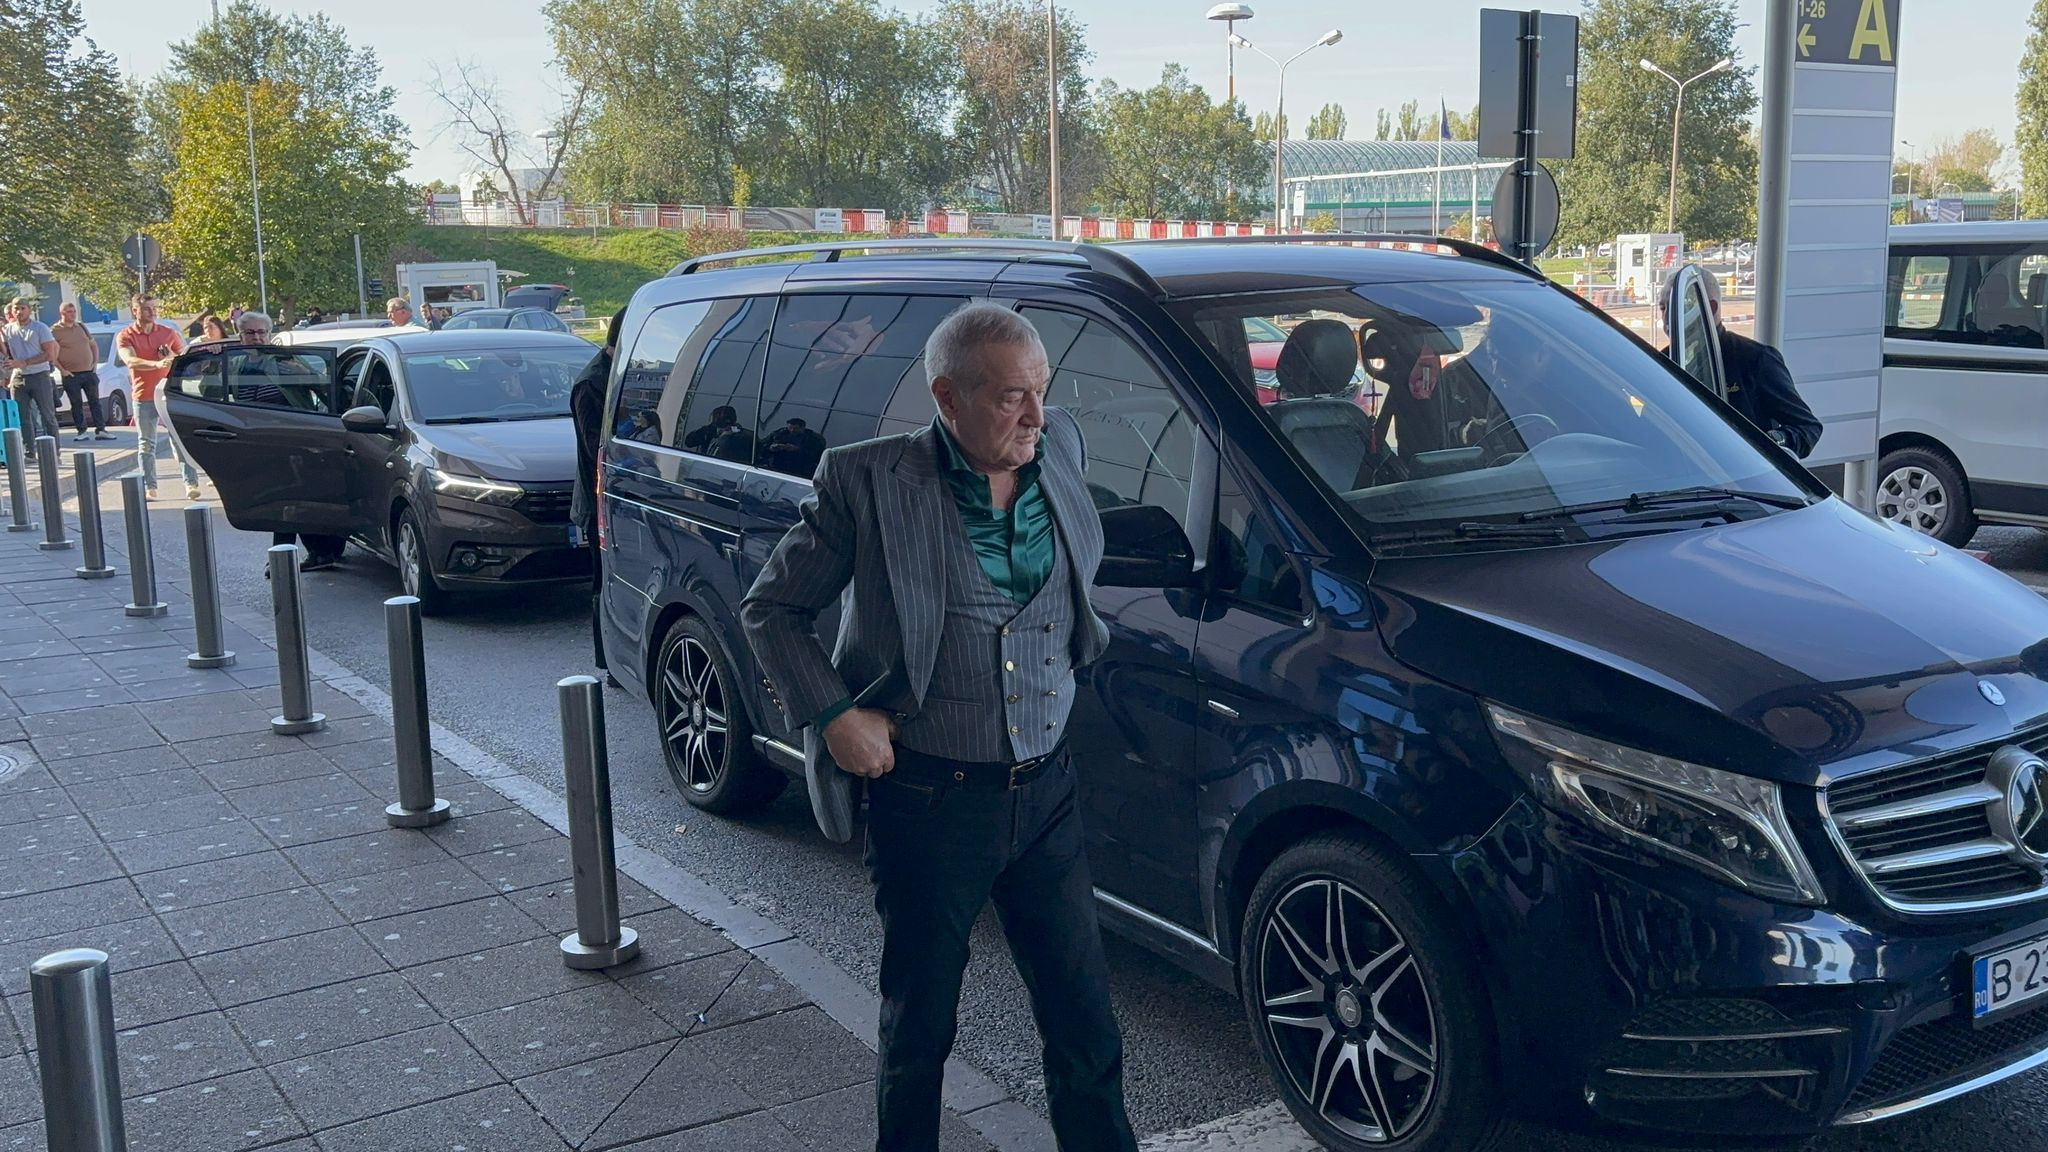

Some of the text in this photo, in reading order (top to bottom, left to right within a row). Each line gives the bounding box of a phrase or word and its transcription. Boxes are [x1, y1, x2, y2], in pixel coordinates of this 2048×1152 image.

[1799, 0, 1826, 18] 1-26
[1848, 0, 1892, 61] A
[1992, 958, 2011, 1004] B
[1974, 990, 1988, 1009] RO
